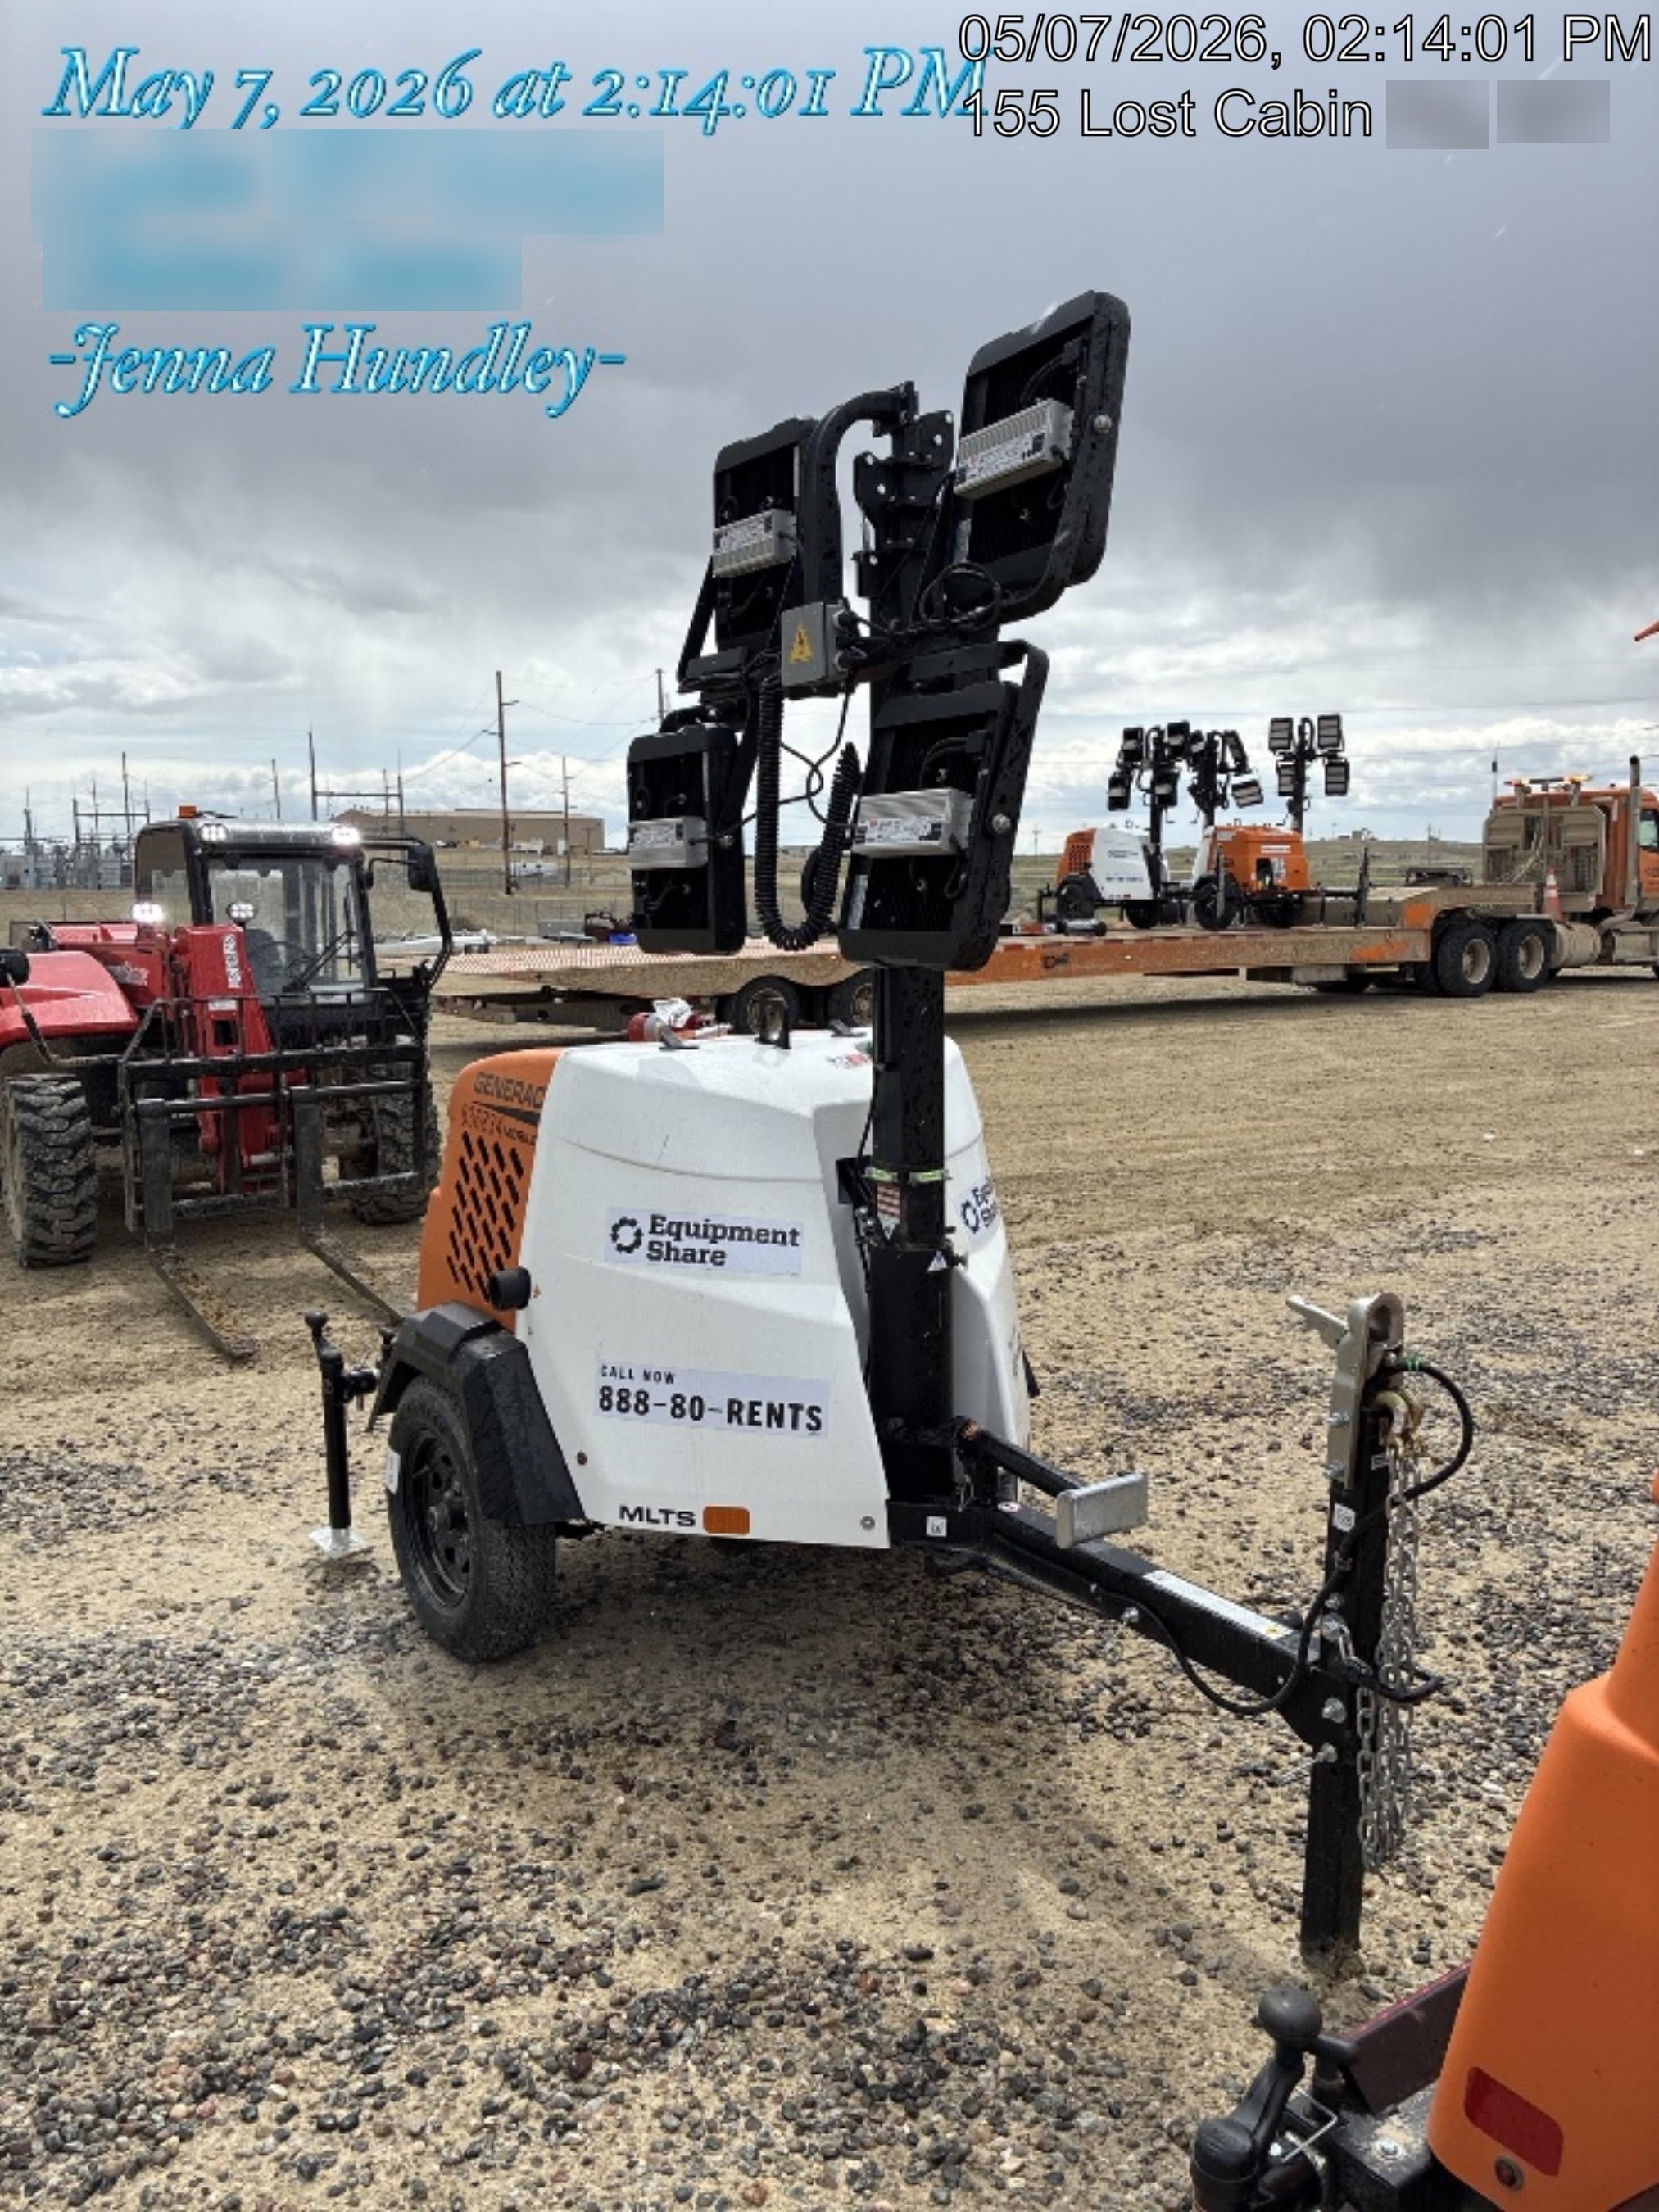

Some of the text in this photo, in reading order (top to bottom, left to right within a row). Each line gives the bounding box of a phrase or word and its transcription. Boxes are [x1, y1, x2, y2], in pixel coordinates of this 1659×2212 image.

[474, 1071, 548, 1108] GENERAC
[648, 1213, 800, 1247] Equipment
[646, 1240, 727, 1266] Share
[601, 1364, 676, 1385] CALL NOW
[598, 1385, 823, 1432] 888-80-RENTS
[619, 1505, 696, 1527] MLTS
